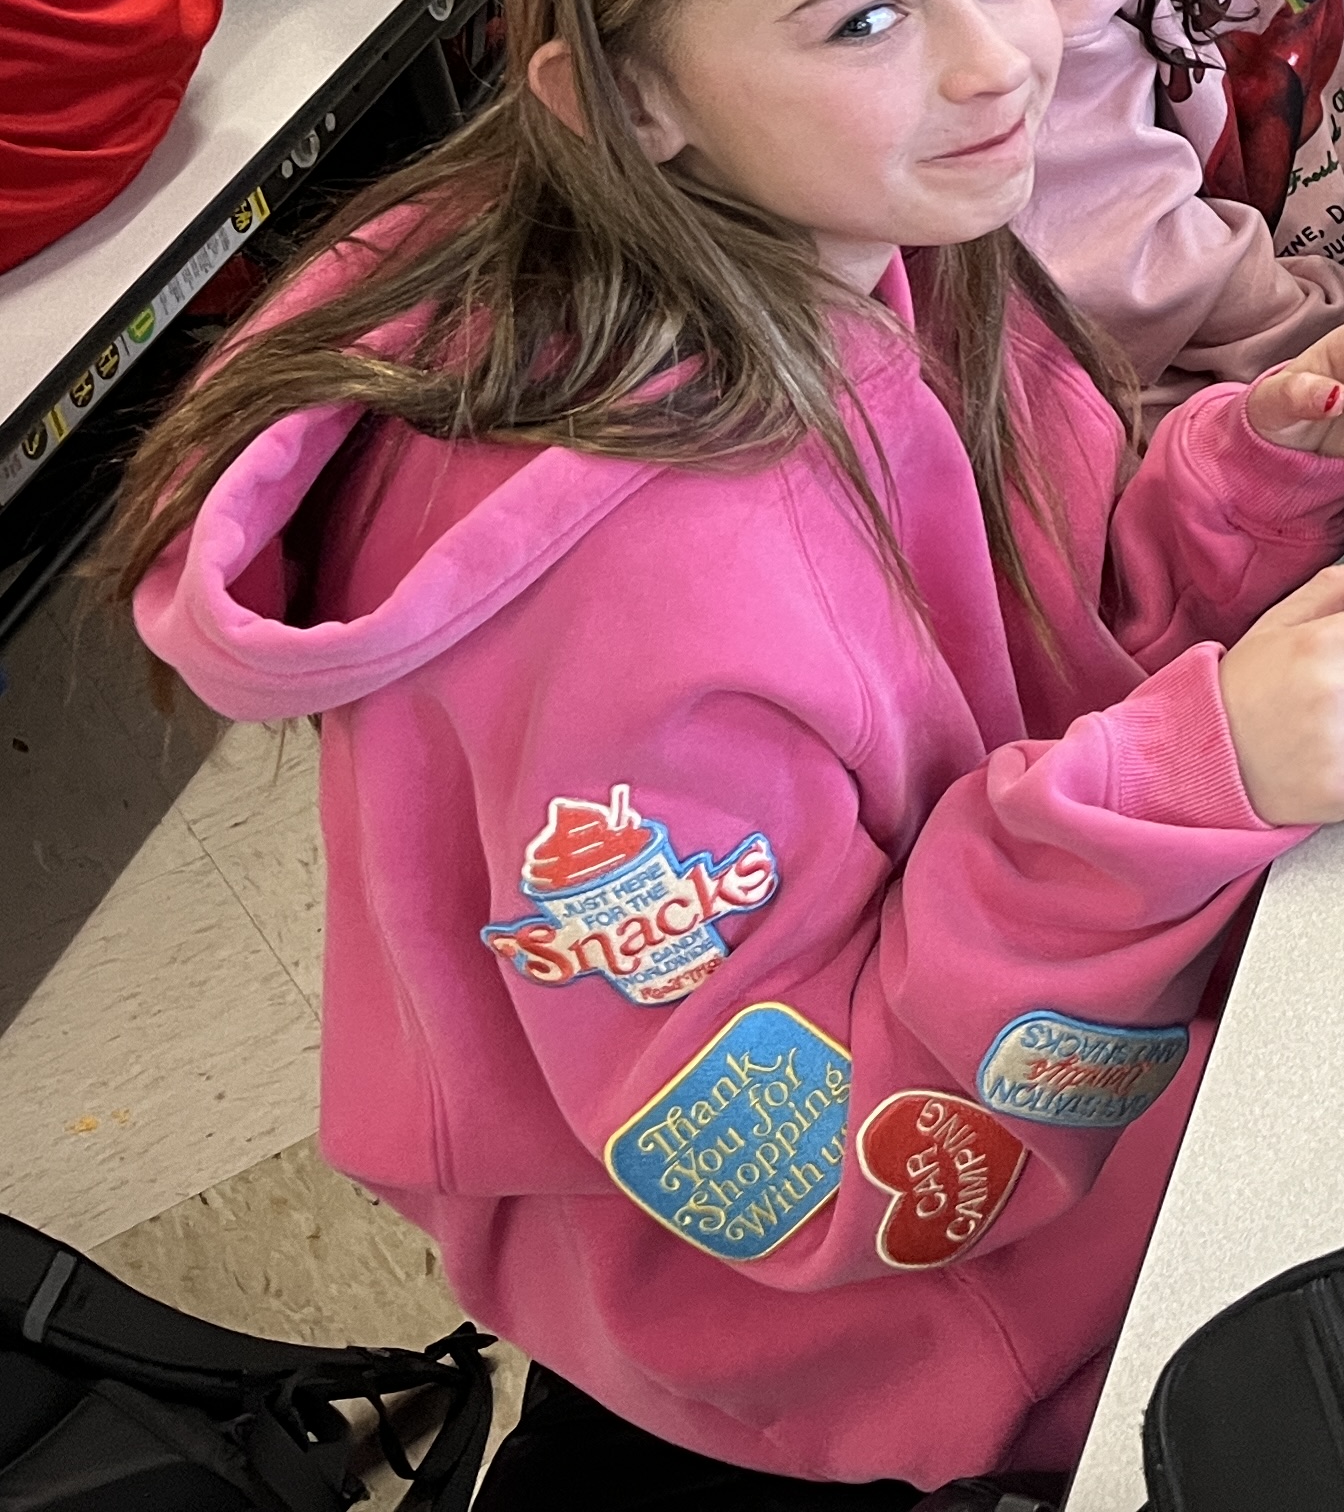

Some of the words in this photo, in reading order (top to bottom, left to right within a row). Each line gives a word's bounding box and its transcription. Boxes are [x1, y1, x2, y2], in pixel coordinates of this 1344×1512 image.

[508, 842, 775, 984] Snacks
[563, 891, 609, 919] JUST
[614, 861, 667, 898] HERE
[583, 905, 626, 930] FOR
[626, 882, 671, 912] THE
[637, 1051, 783, 1165] Thank
[660, 1126, 746, 1193] You
[748, 1046, 802, 1138] for
[674, 1061, 852, 1234] Shopping
[725, 1161, 824, 1241] With
[906, 1143, 947, 1220] CAR
